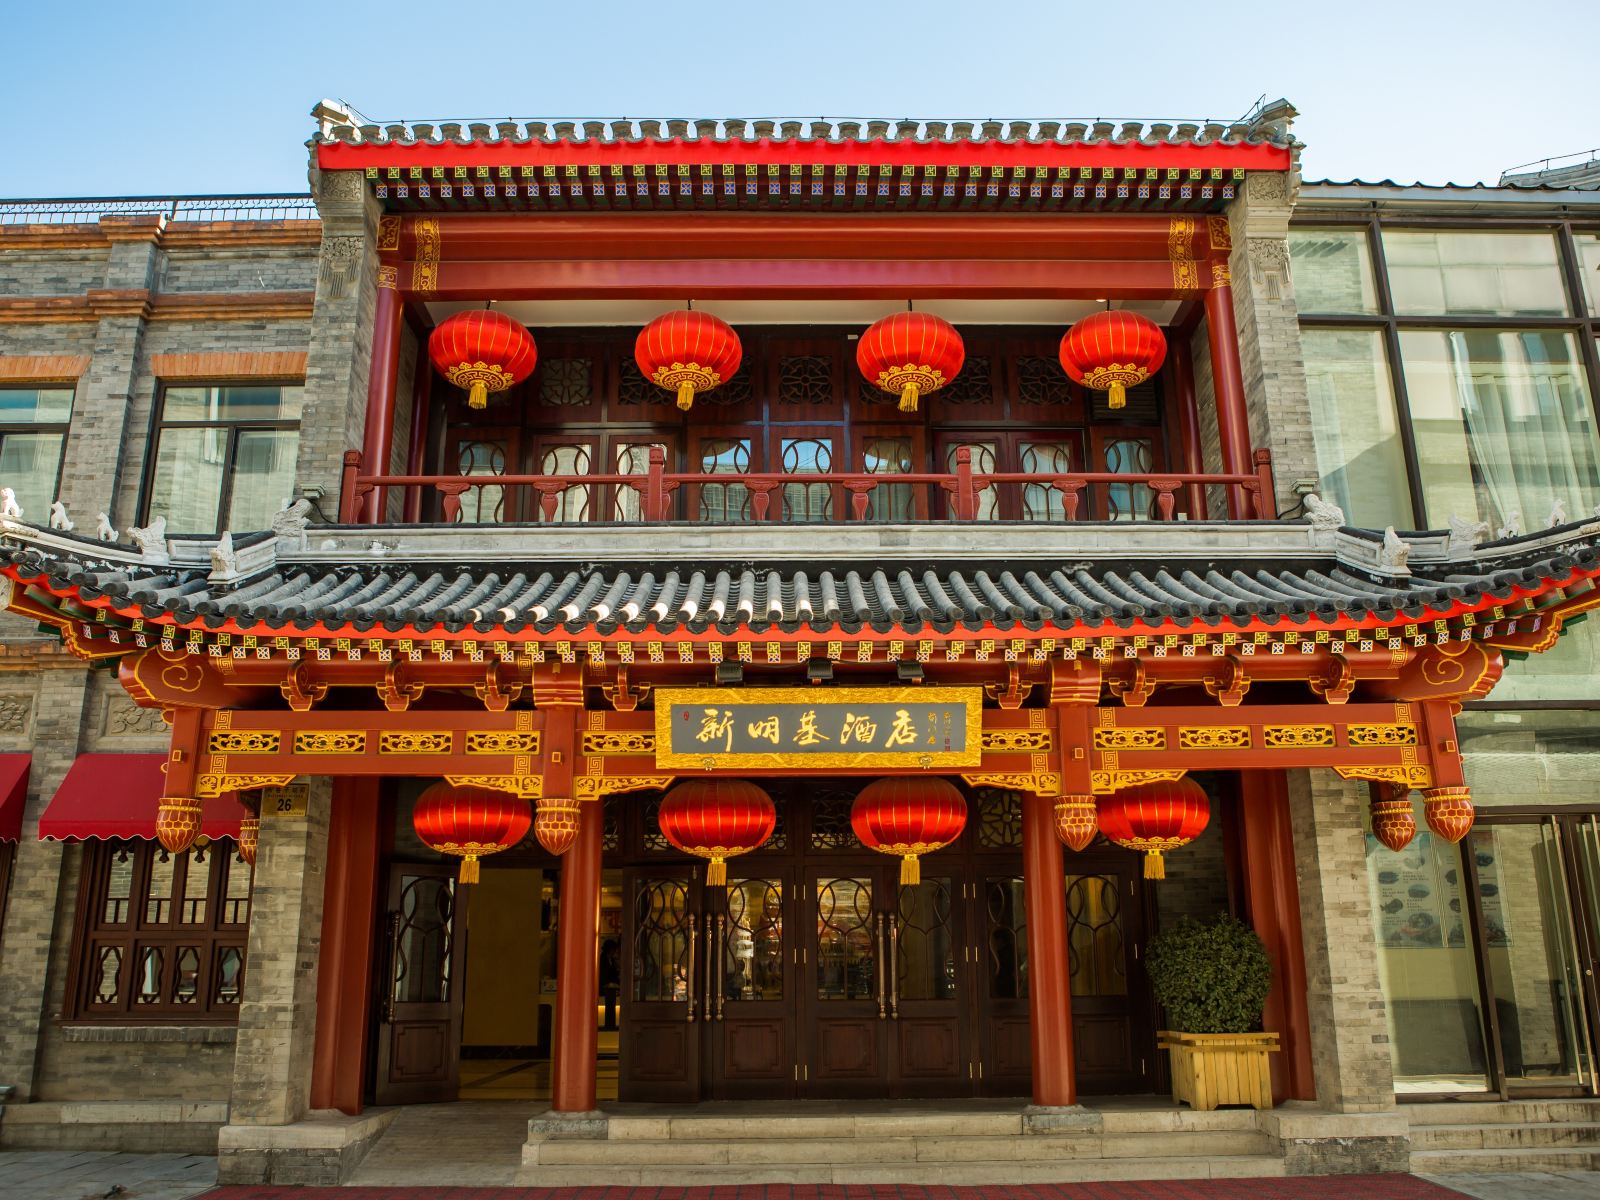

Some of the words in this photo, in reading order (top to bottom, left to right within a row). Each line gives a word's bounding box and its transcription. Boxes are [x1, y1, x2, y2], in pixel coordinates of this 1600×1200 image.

[696, 708, 918, 752] 新明基酒店
[277, 798, 292, 811] 26
